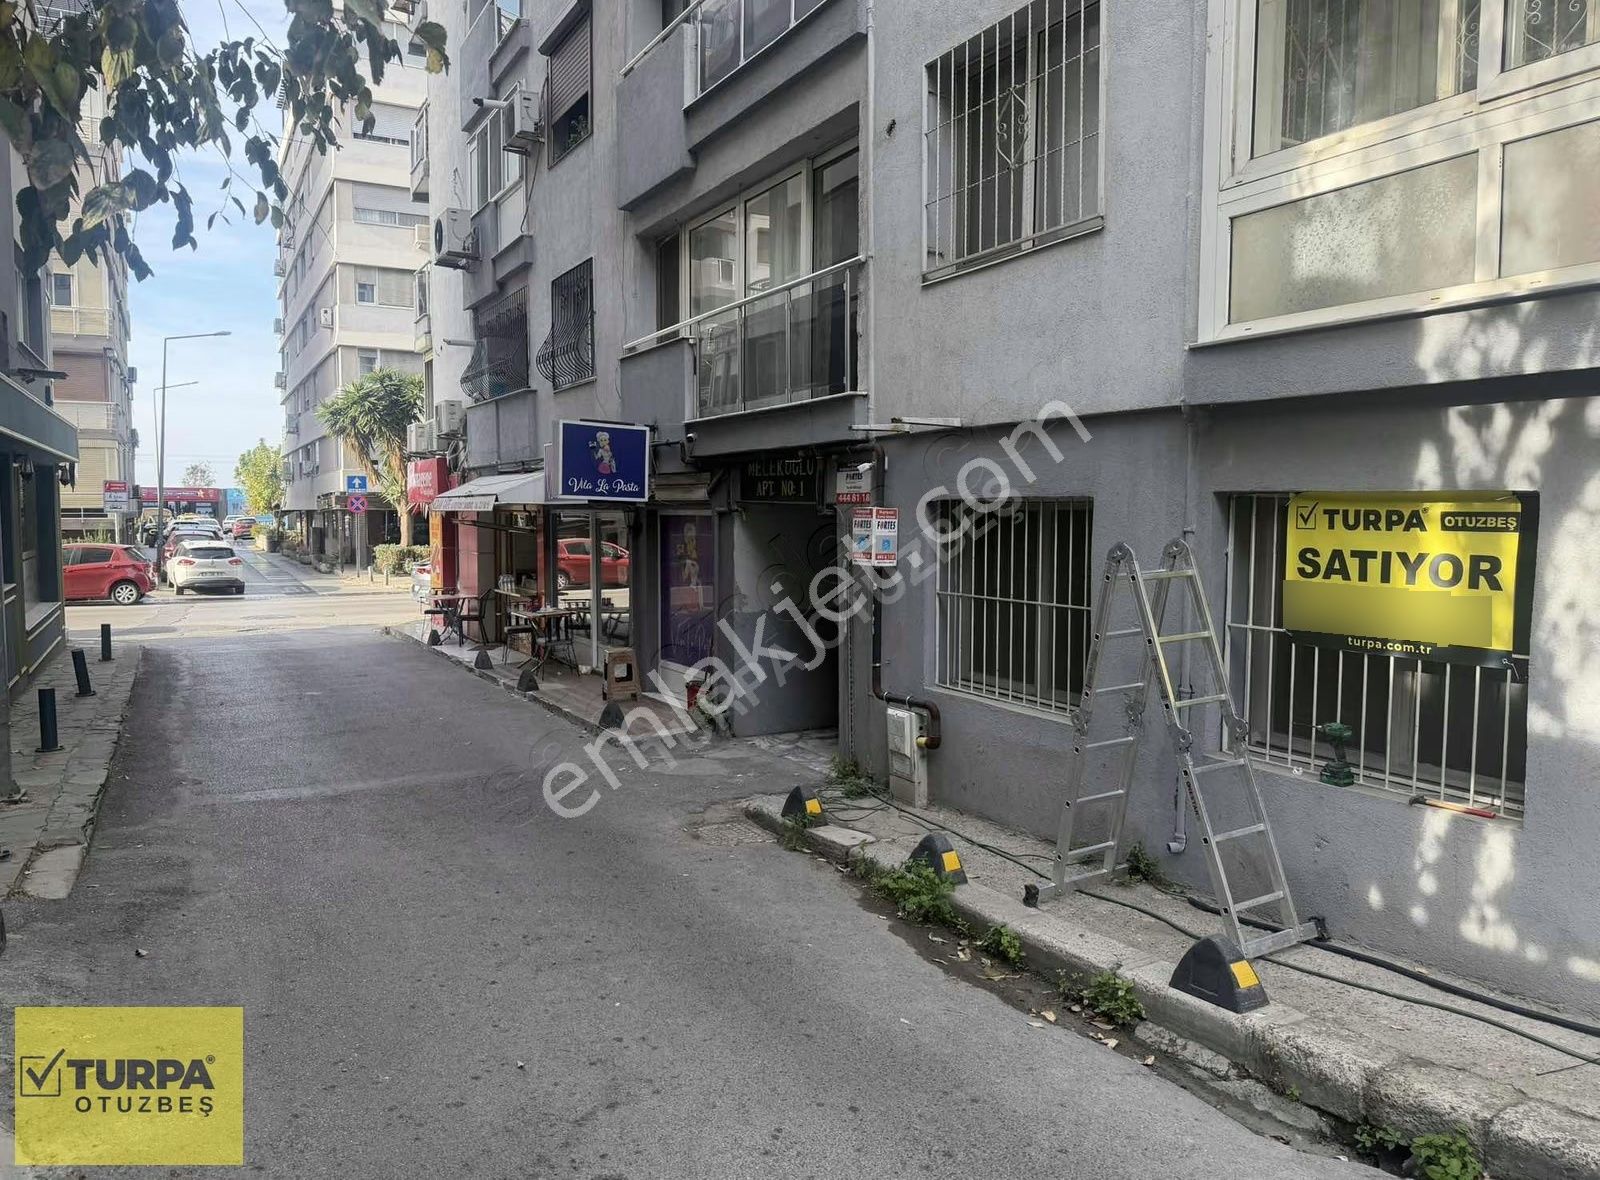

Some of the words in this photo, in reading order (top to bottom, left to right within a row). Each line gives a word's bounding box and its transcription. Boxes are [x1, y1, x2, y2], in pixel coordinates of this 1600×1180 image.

[595, 478, 610, 494] La
[612, 478, 640, 493] Pasta
[1323, 508, 1428, 532] TURPA
[1444, 514, 1518, 530] OTUZBEŞ
[1296, 546, 1504, 592] SATIYOR
[1347, 636, 1432, 655] turpa.com.tr
